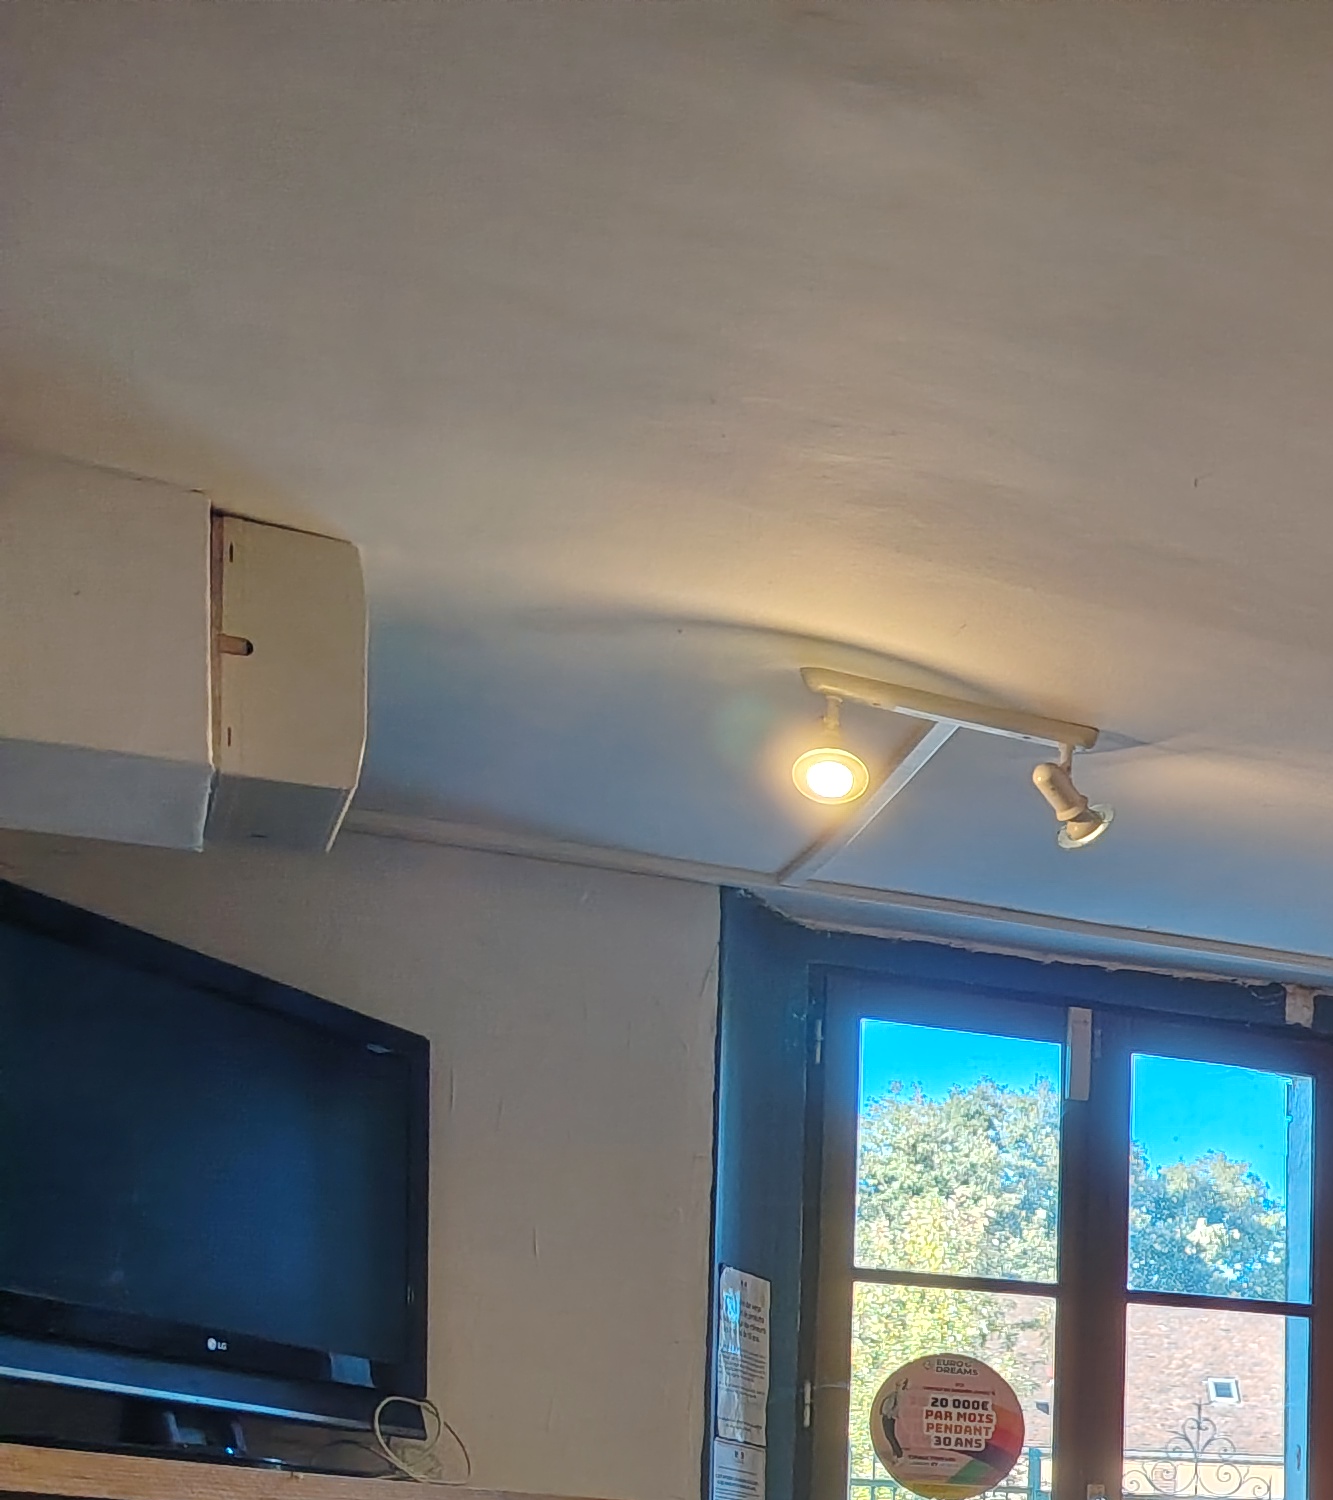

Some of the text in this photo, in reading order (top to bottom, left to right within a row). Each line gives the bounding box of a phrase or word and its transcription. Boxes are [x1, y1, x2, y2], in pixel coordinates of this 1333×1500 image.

[217, 1342, 227, 1350] LG
[936, 1359, 964, 1367] EURO
[935, 1366, 978, 1376] DREAMS
[931, 1397, 950, 1408] 20
[925, 1409, 994, 1424] PAR MOIS
[926, 1422, 992, 1437] PENDANT
[933, 1435, 983, 1448] 30 ANS
